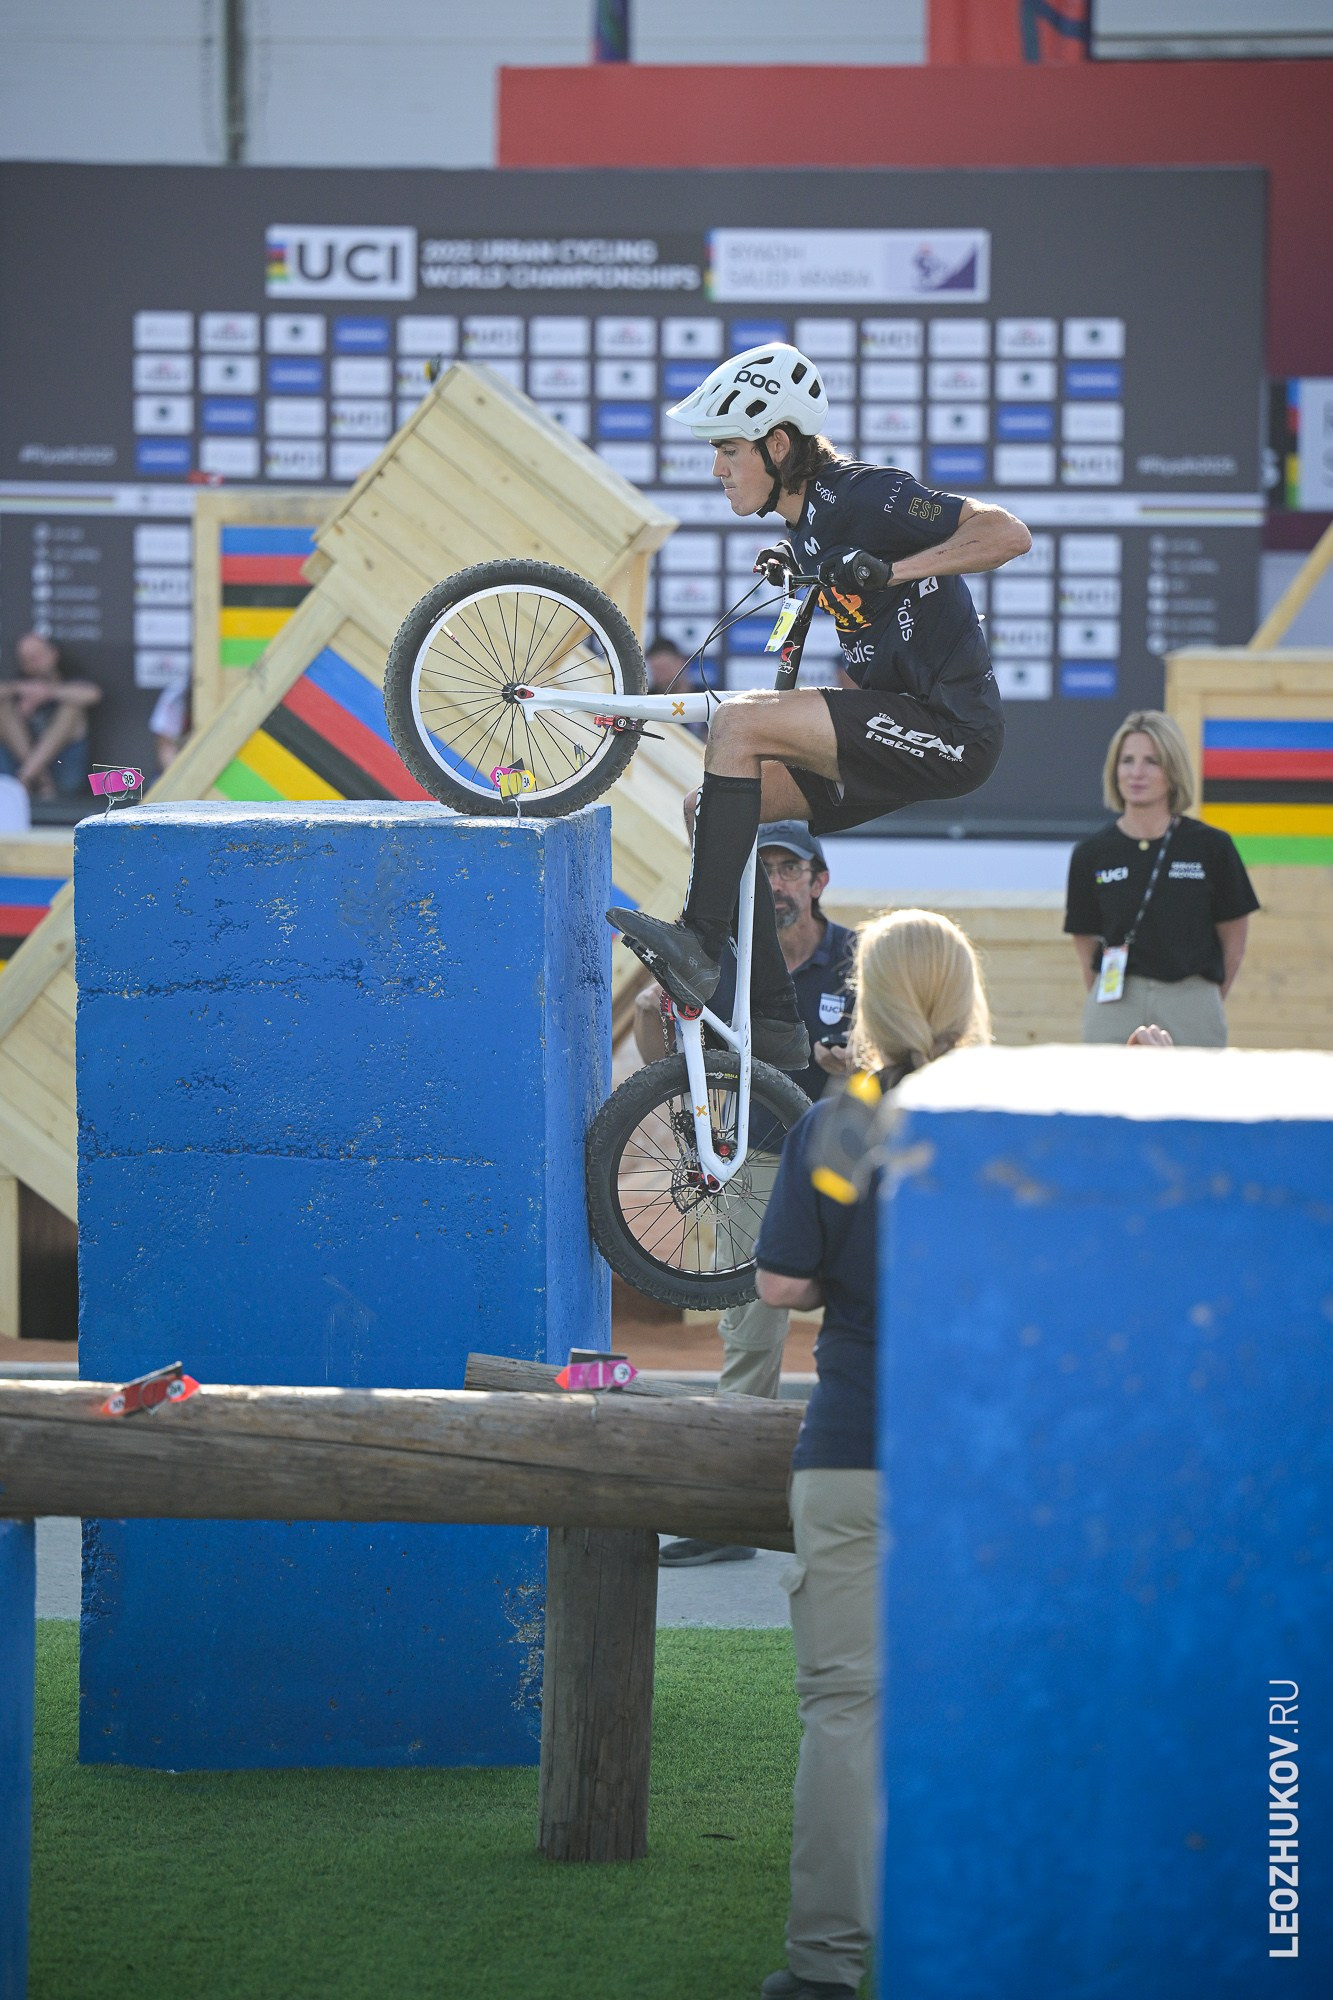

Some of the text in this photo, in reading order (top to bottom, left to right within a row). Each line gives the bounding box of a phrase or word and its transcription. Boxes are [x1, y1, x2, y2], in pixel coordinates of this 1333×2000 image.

[298, 243, 398, 282] UCI
[557, 238, 658, 264] CYCLING
[420, 265, 702, 291] WORLD CHAMPIONSHIPS
[907, 496, 943, 521] ESP
[866, 716, 965, 760] CLEAN
[1101, 866, 1128, 883] UCI
